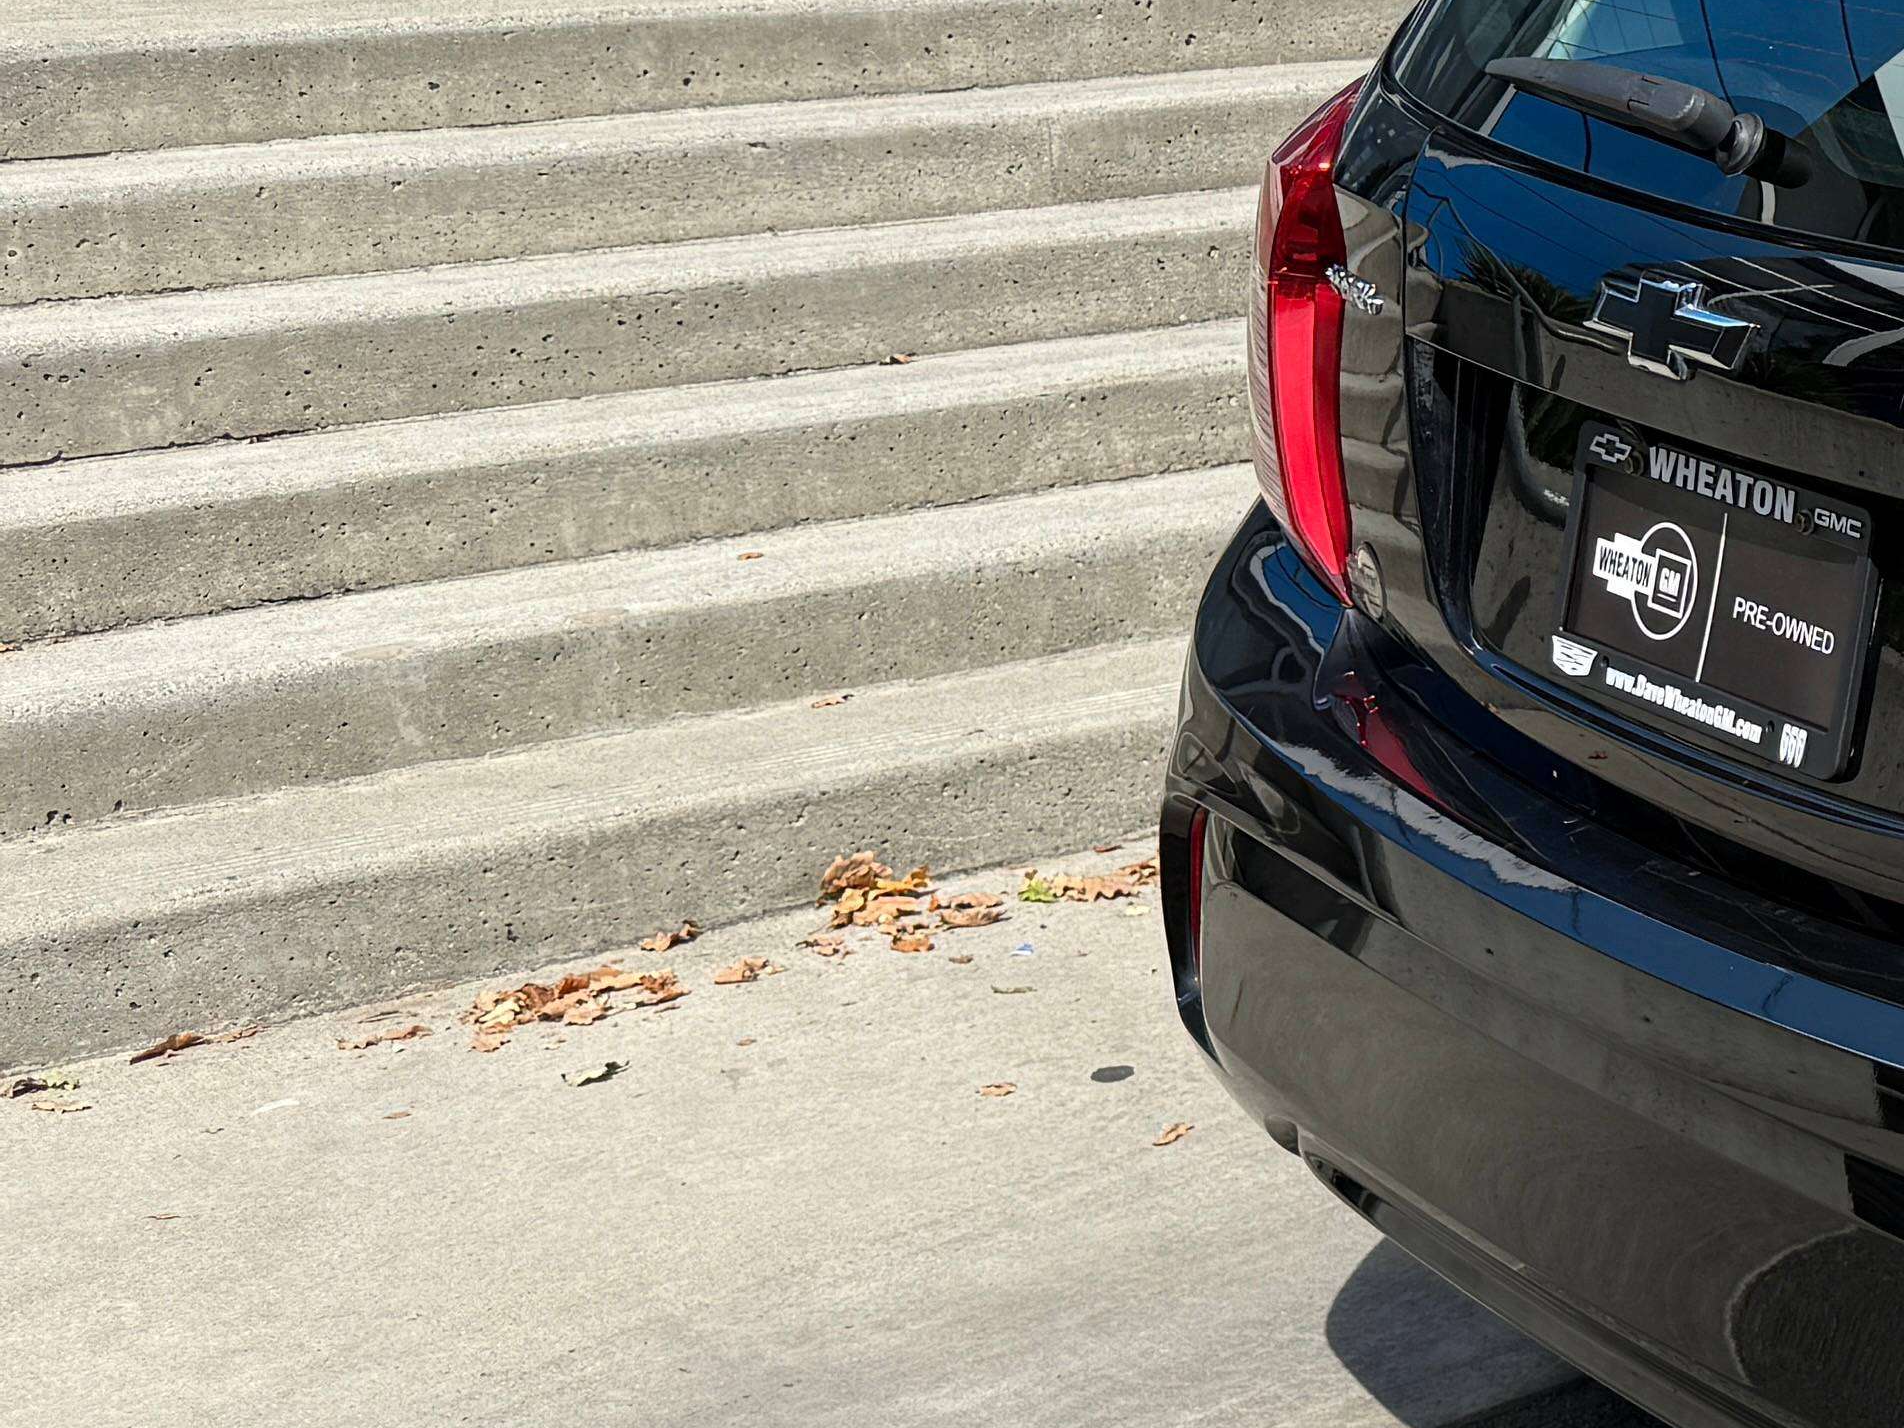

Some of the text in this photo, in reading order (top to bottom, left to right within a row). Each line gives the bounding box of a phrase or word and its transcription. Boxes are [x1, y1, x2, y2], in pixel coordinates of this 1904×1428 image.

[1650, 446, 1796, 524] WHEATON
[1813, 507, 1862, 539] GMC
[1599, 544, 1653, 588] WHEATON
[1659, 566, 1682, 597] GM
[1732, 596, 1835, 655] PRE-OWNED
[1605, 666, 1763, 745] www.DaveWheatonGM.com
